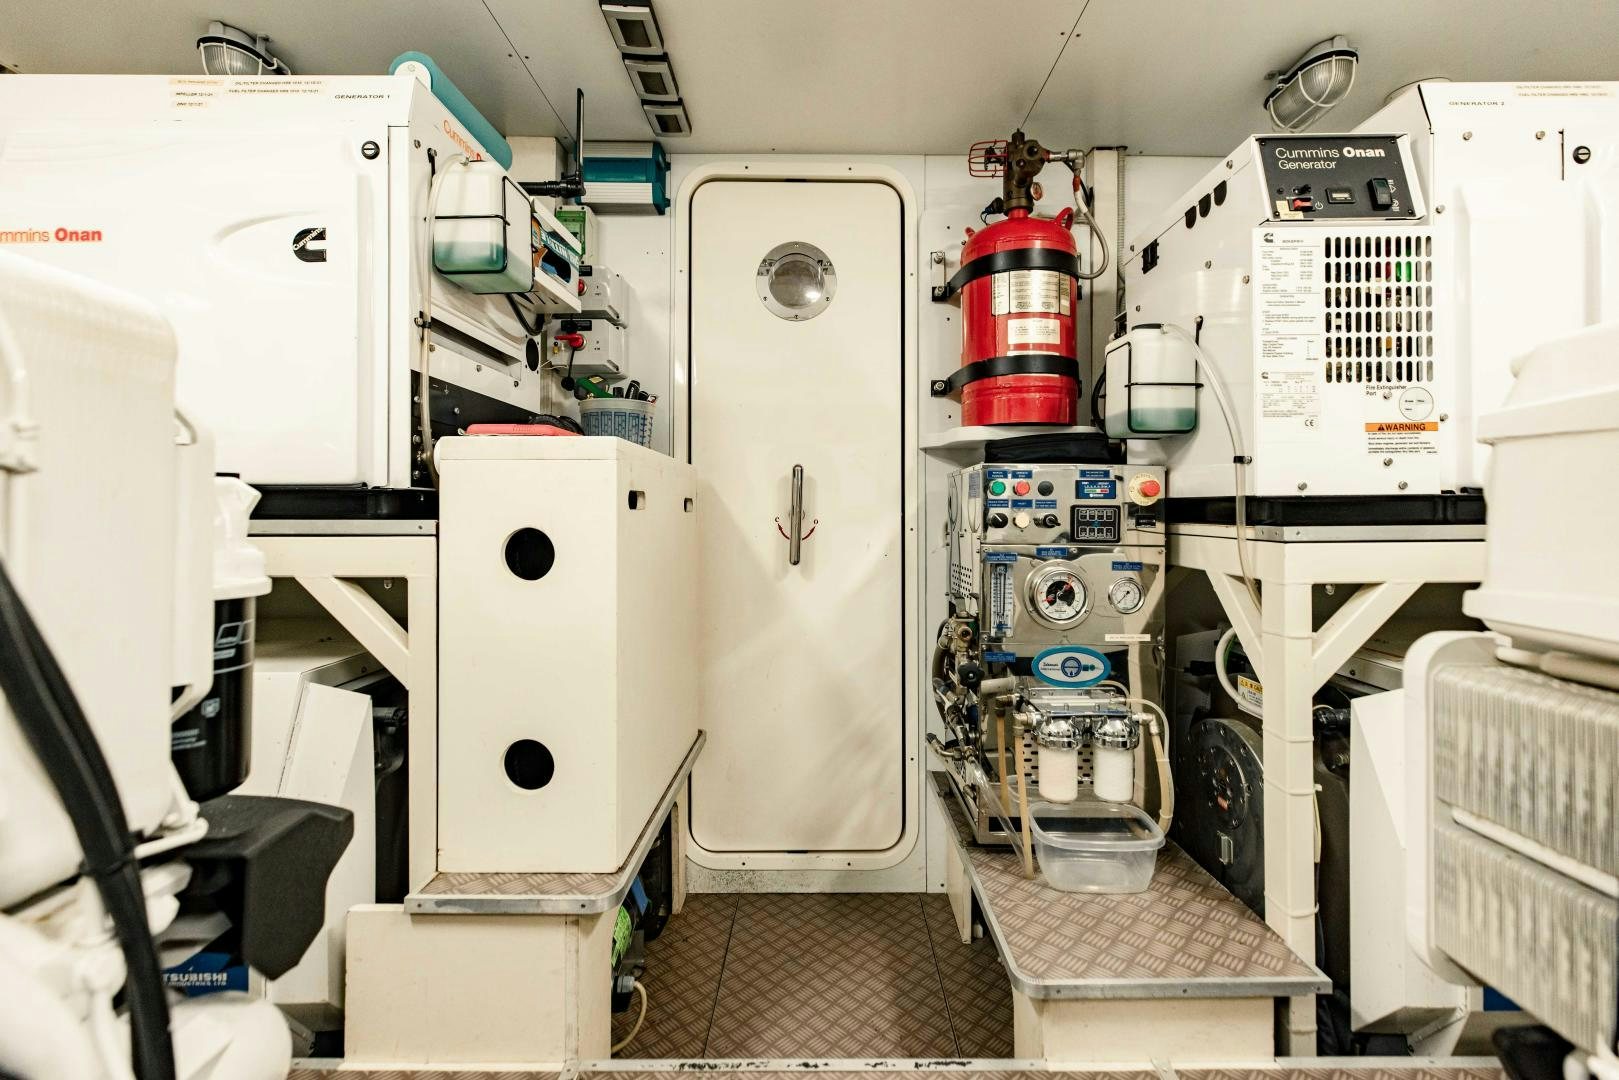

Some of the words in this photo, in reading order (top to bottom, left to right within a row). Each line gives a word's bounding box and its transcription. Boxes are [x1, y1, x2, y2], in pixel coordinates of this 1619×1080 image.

[1275, 147, 1340, 159] Cummins
[1342, 146, 1386, 158] Onan
[1278, 160, 1337, 170] Generator
[54, 227, 102, 242] Onan
[1385, 423, 1426, 431] WARNING
